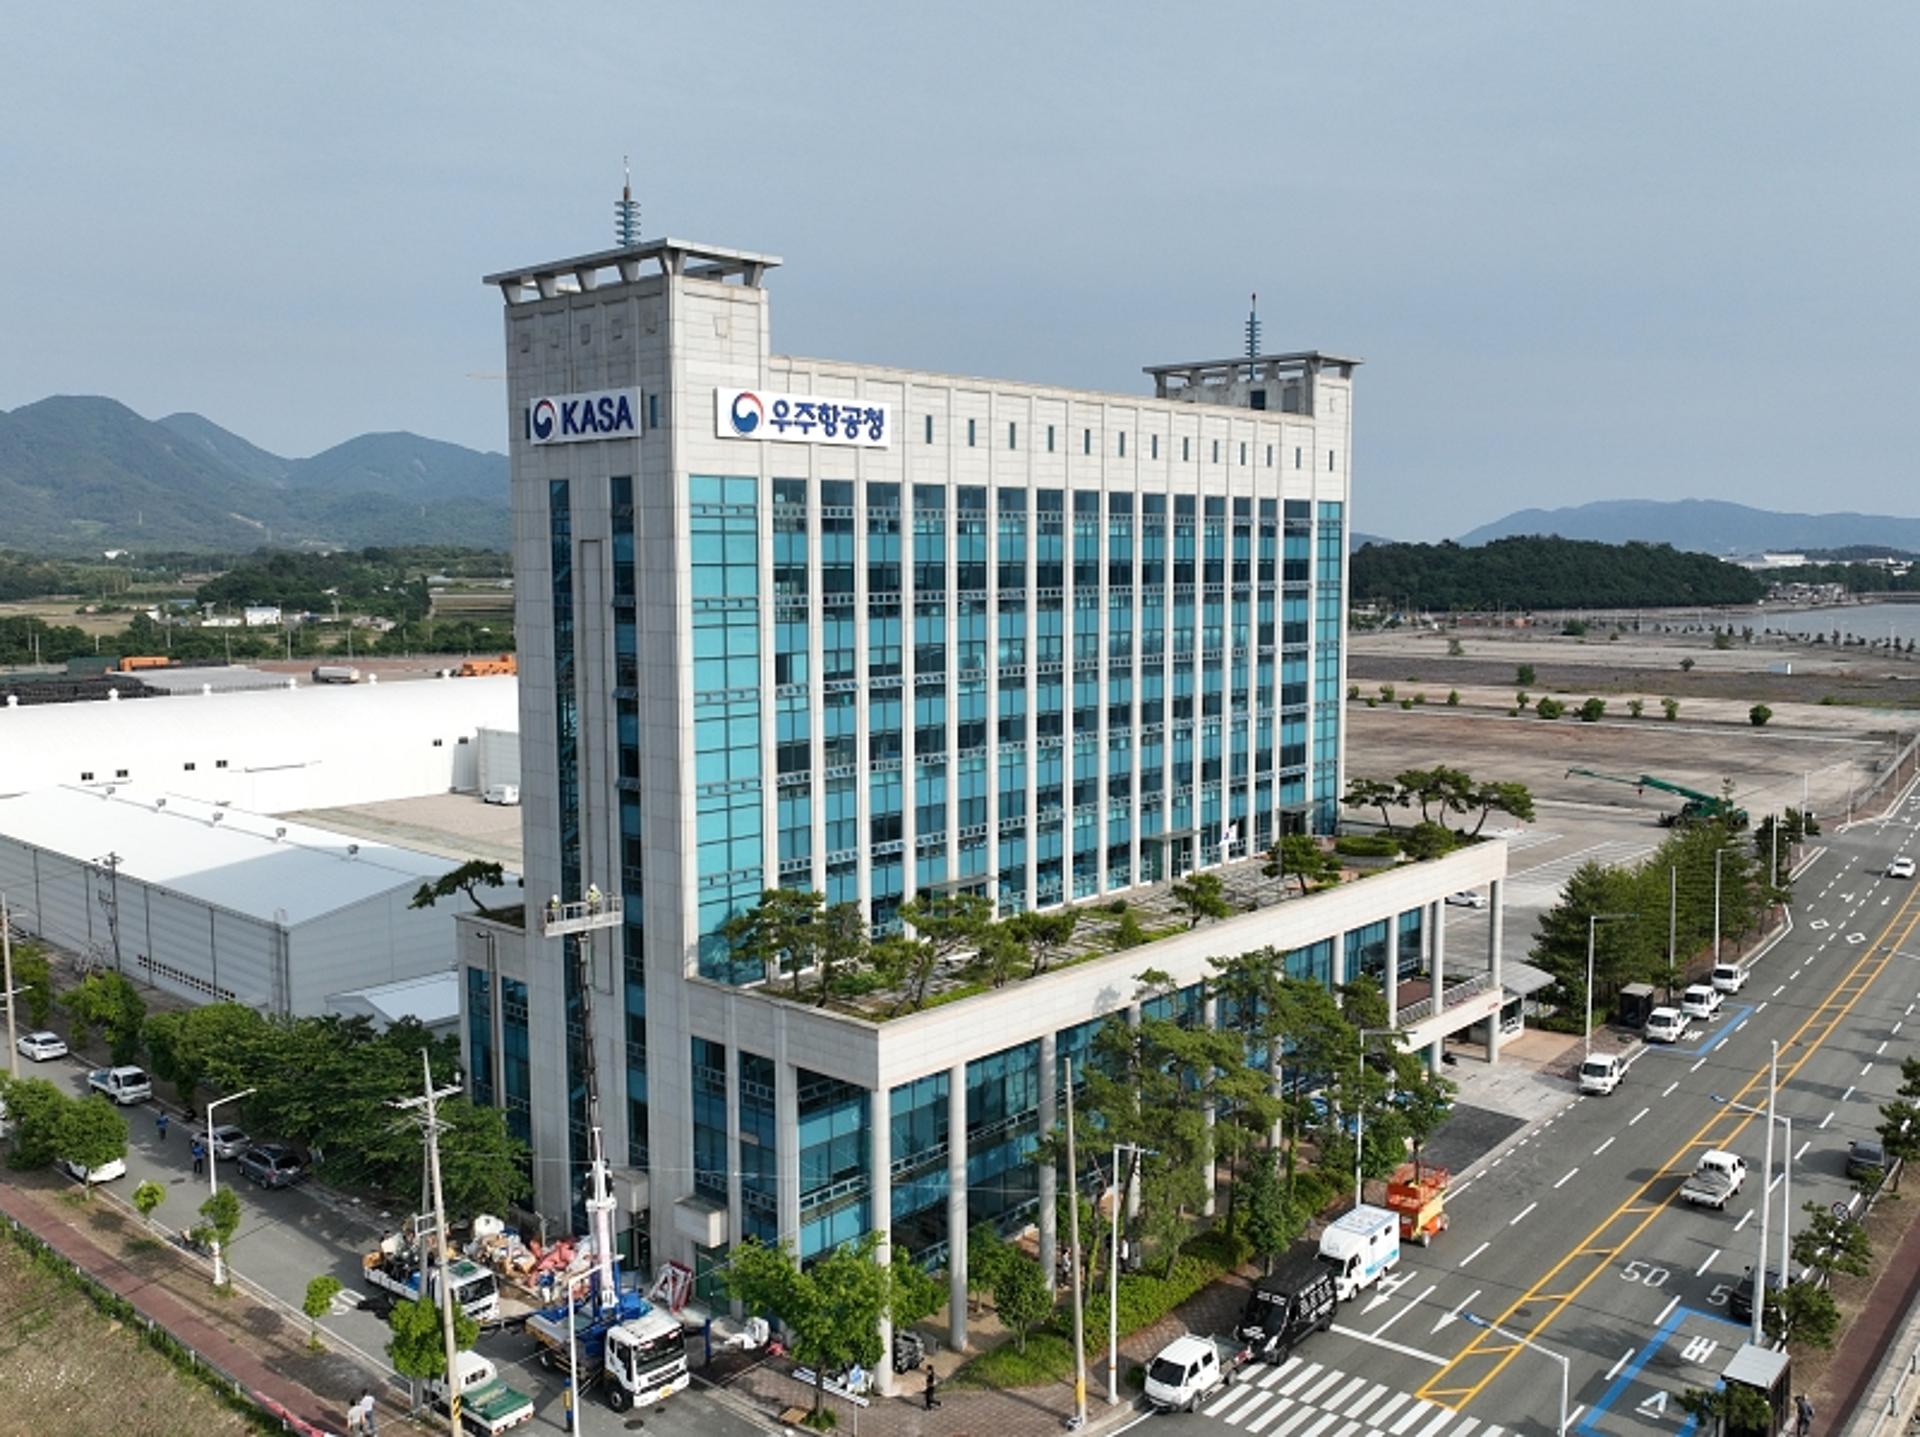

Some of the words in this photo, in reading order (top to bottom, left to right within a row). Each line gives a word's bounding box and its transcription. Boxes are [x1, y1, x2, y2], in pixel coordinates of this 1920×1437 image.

[561, 395, 634, 435] KASA
[769, 399, 884, 441] 우주항공청
[1619, 1261, 1670, 1287] 50
